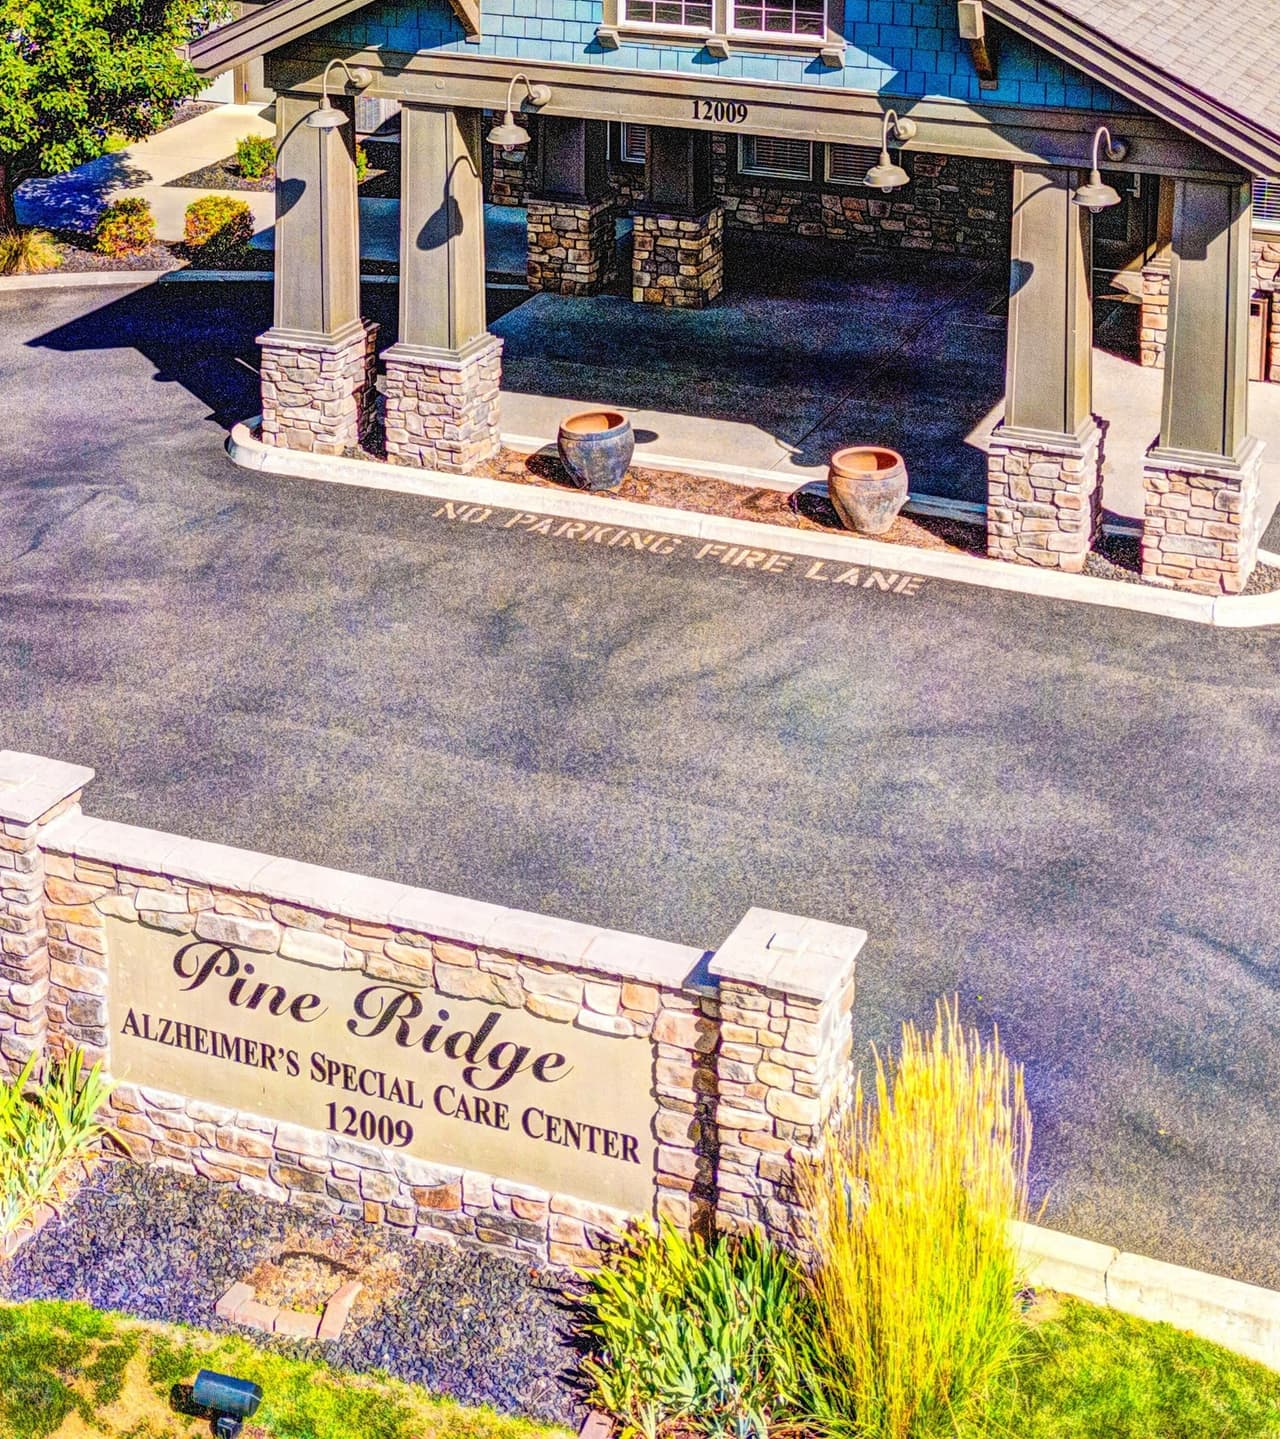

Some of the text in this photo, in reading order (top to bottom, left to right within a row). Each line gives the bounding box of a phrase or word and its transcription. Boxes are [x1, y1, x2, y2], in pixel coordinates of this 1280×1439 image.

[692, 99, 748, 124] 12009
[432, 502, 926, 596] NO PARKING FIRE LANE
[172, 940, 573, 1091] Pine Ridge
[120, 1007, 641, 1164] ALZHEIMER'S SPECIAL CARE CENTER
[324, 1100, 415, 1148] 12009
